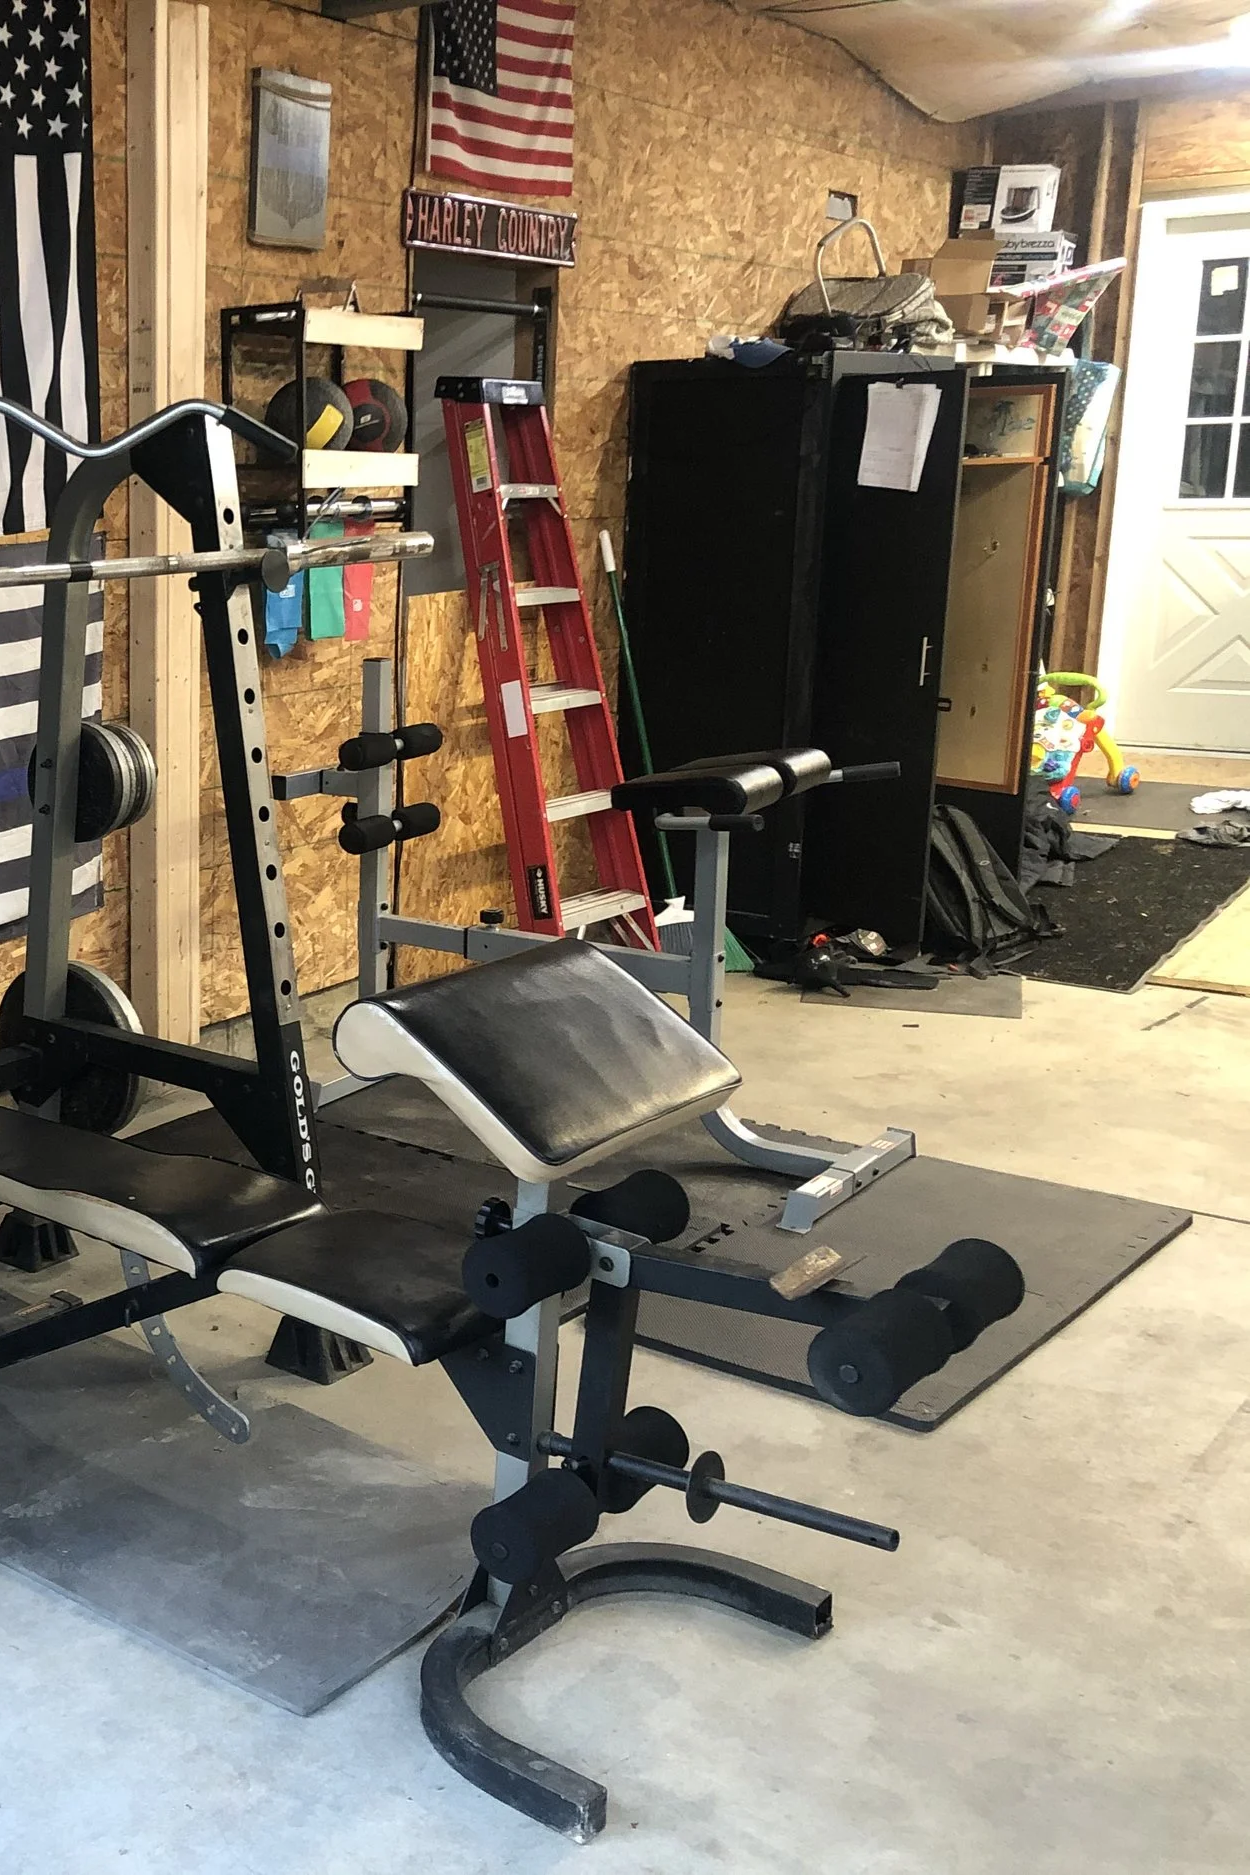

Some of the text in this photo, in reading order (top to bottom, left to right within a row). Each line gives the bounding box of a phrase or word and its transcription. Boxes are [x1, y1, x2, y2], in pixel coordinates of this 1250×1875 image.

[417, 195, 569, 261] HARLEY COUNTRY
[536, 878, 549, 915] HUSKY
[290, 1050, 312, 1163] GOLD'S
